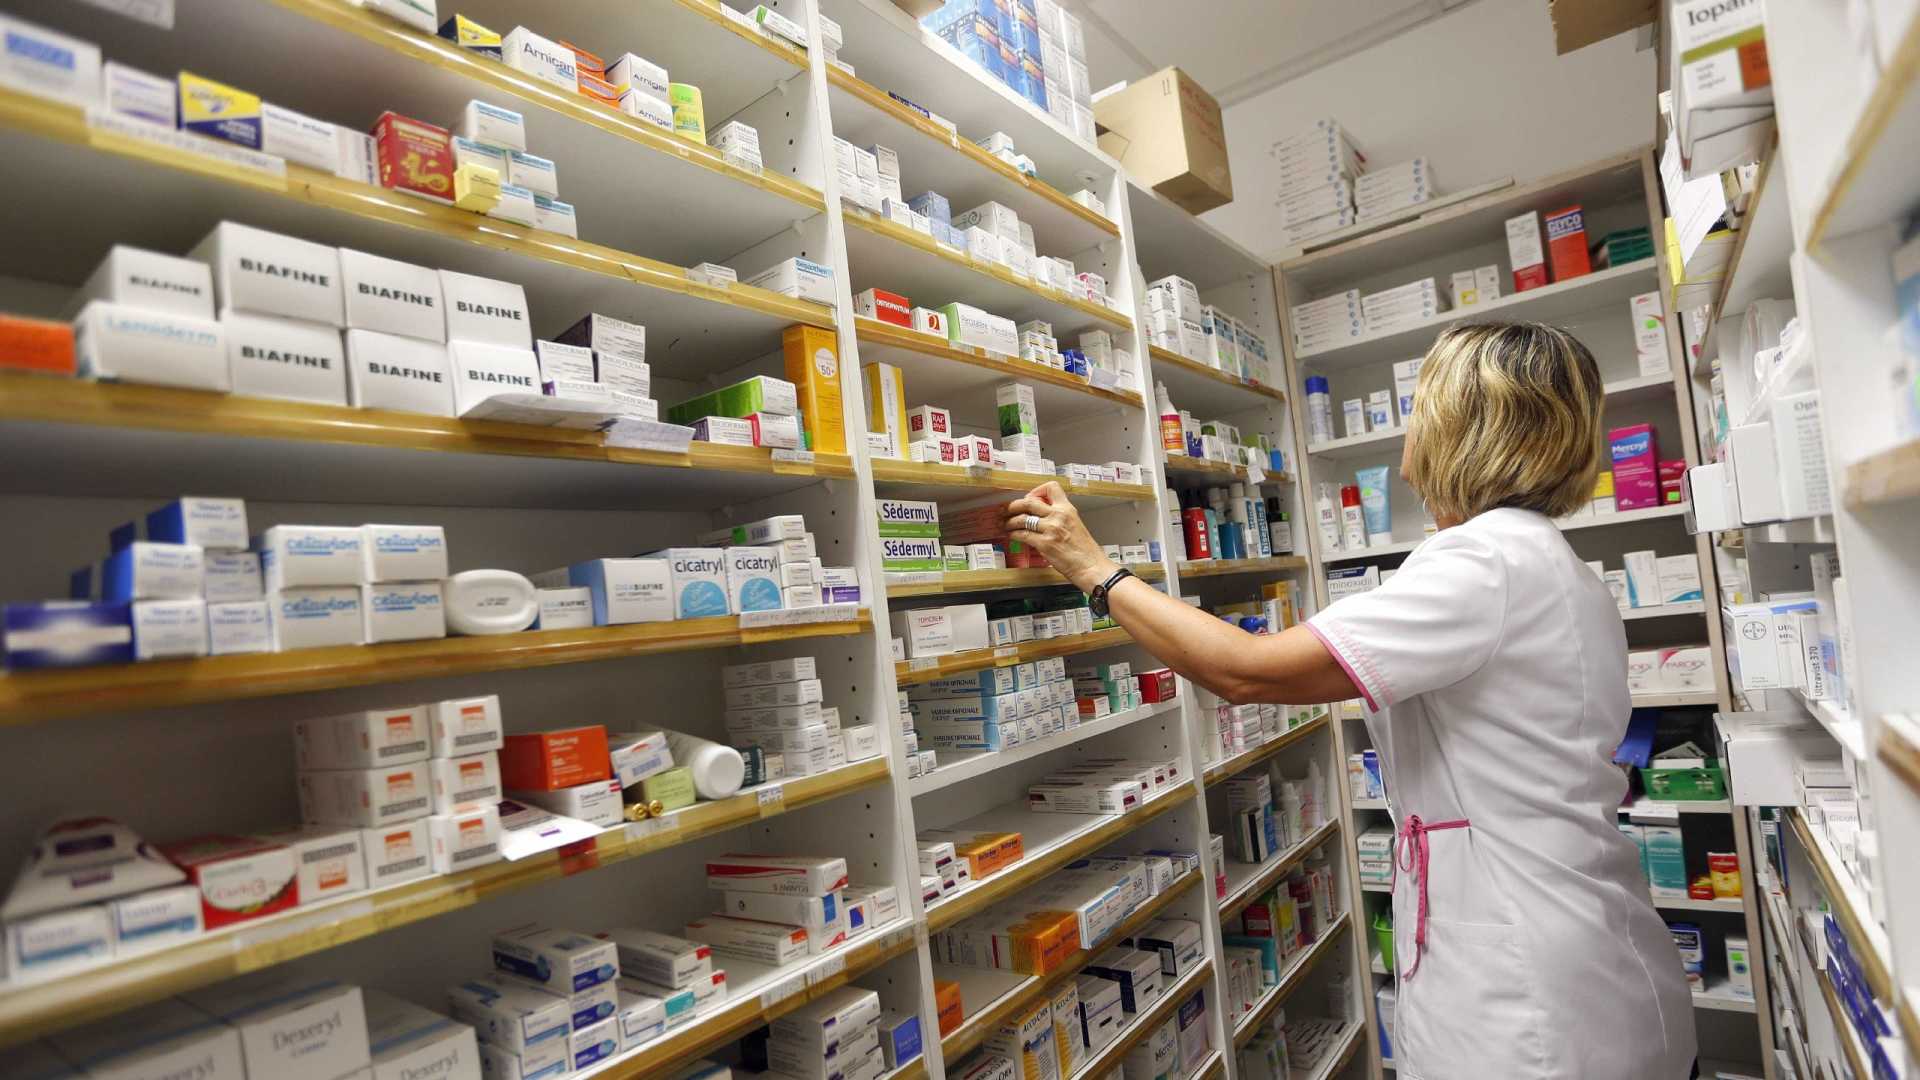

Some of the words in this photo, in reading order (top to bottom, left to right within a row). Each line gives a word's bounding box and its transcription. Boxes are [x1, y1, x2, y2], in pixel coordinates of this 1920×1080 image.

[523, 42, 575, 74] Arnican
[634, 73, 667, 95] Arnigel
[638, 108, 673, 131] Arnigel
[240, 257, 329, 287] BIAFINE
[128, 275, 201, 296] BIAFINE
[358, 282, 434, 309] BIAFINE
[457, 301, 522, 321] BIAFINE
[241, 345, 331, 370] BIAFINE
[368, 362, 443, 384] BIAFINE
[468, 369, 533, 389] BIAFINE
[883, 502, 935, 524] Sédermyl
[884, 541, 937, 561] Sédermyl
[674, 557, 723, 576] cicatryl
[735, 556, 778, 574] cicatryl
[1809, 664, 1824, 697] Ultravist
[272, 1009, 343, 1052] Dexeryl
